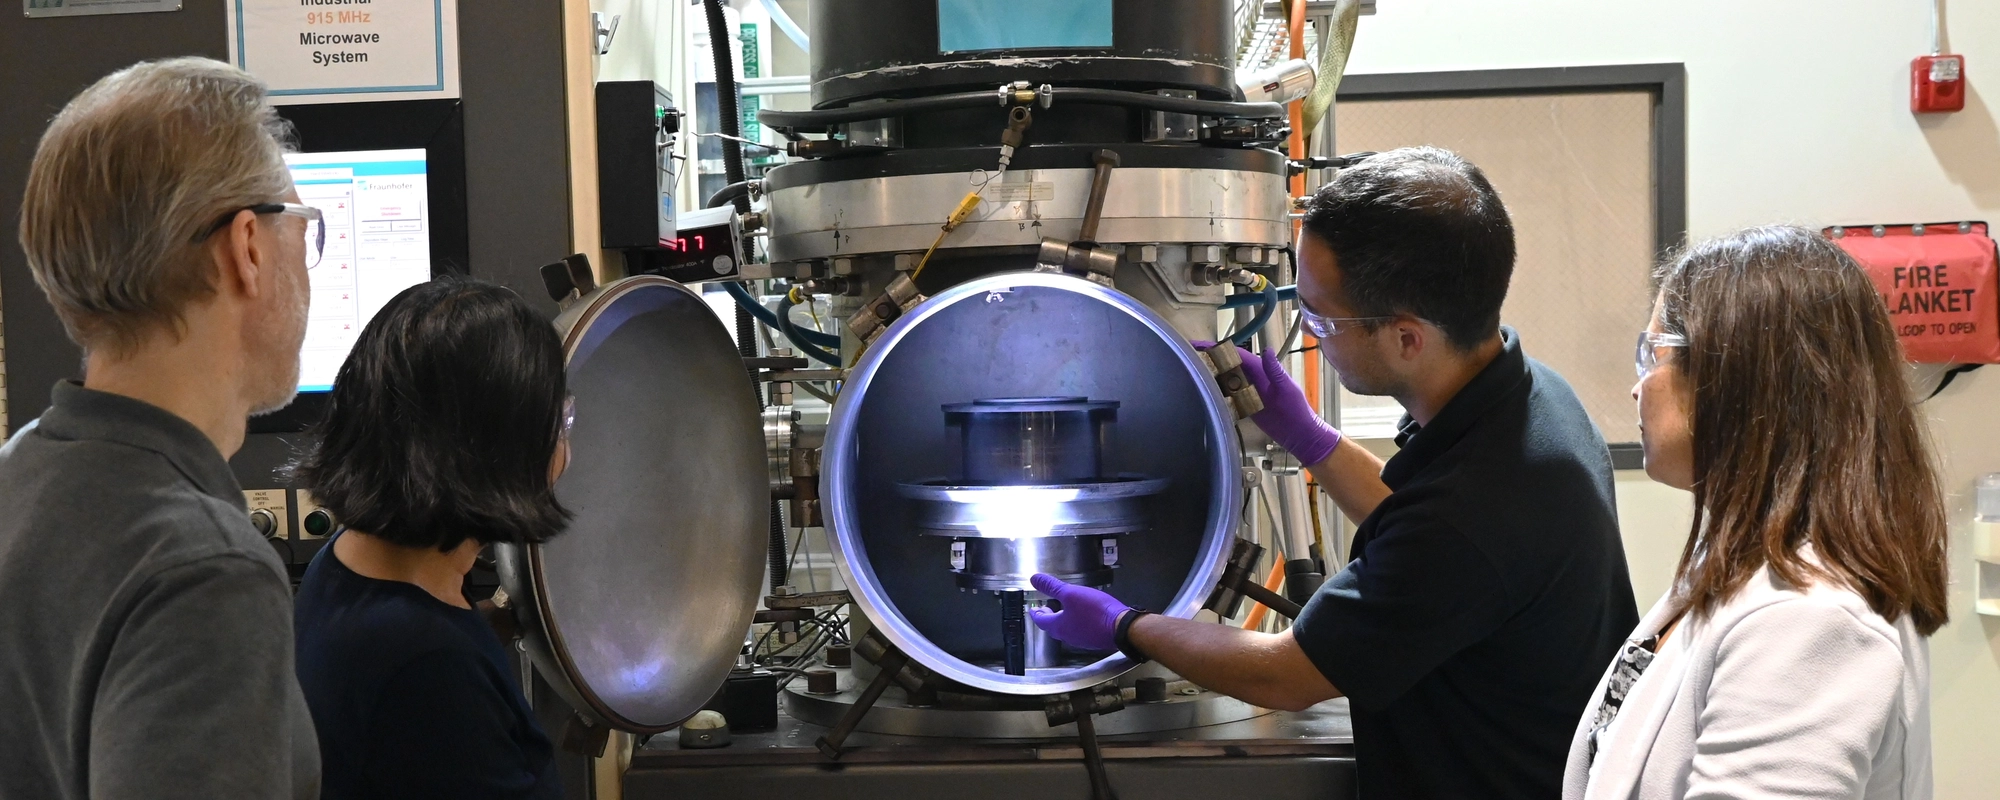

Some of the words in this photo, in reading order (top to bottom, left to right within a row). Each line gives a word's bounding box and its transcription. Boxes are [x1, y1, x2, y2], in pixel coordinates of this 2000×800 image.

[307, 11, 334, 25] 915
[339, 10, 371, 24] MHz
[300, 32, 380, 45] Microwave
[312, 50, 368, 67] System
[370, 182, 413, 191] Fraunhofer
[1893, 264, 1949, 289] FIRE
[1883, 288, 1976, 315] LANKET
[1930, 322, 1945, 336] TO
[1948, 321, 1977, 335] OPEN
